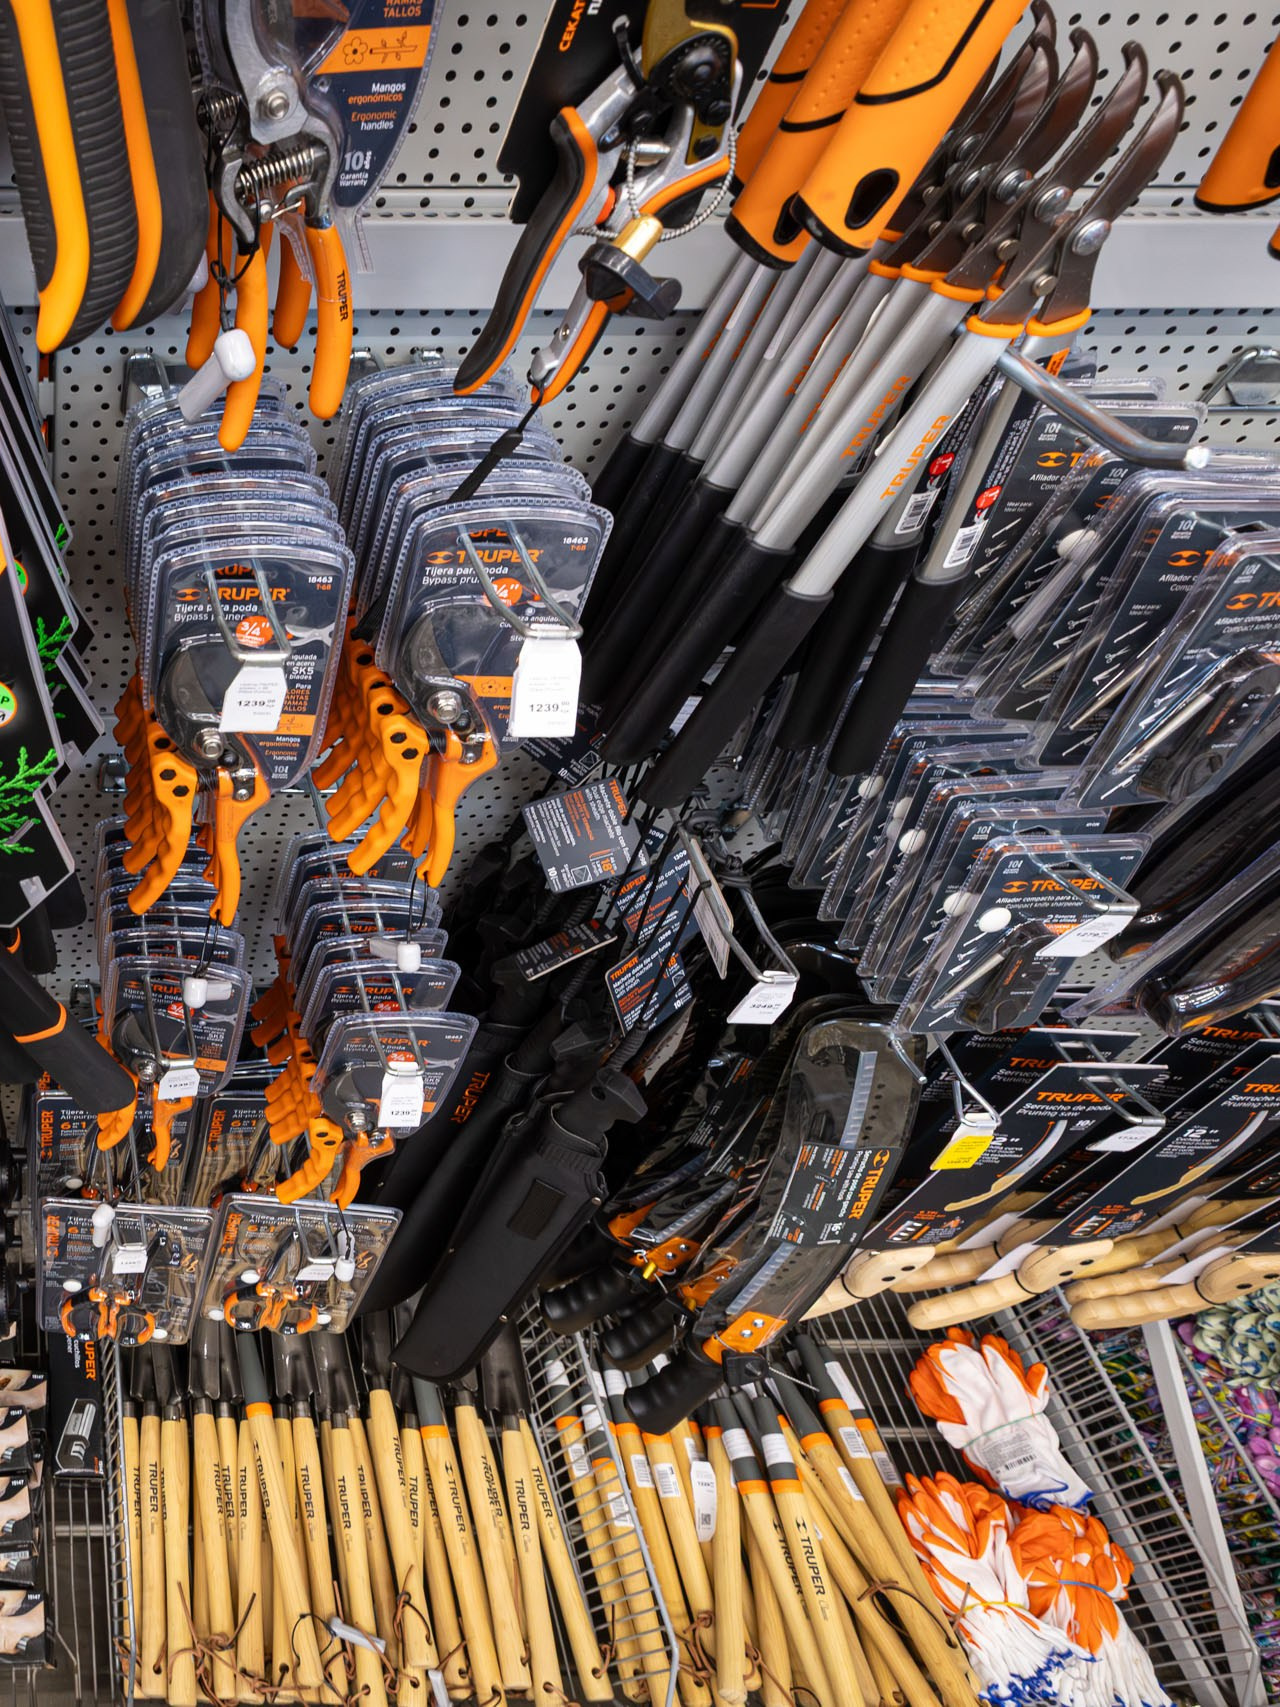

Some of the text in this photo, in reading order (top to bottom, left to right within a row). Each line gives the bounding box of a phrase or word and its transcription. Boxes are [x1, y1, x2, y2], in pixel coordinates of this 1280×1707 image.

[384, 6, 421, 17] TALLOS
[348, 92, 403, 105] ergonómicos
[372, 82, 406, 94] Mangos
[351, 110, 397, 123] Ergonomic
[360, 119, 394, 131] handles
[344, 152, 364, 171] 10
[339, 178, 368, 187] Warranty
[336, 269, 350, 322] TRUPER
[839, 375, 912, 460] TRUPER
[880, 414, 952, 500] TRUPER
[1029, 474, 1058, 482] Afilador
[563, 536, 589, 544] 18463
[308, 575, 333, 584] 18463
[422, 576, 457, 585] Bypass
[424, 566, 454, 577] Tijera
[1158, 574, 1190, 582] Afilador
[174, 613, 209, 623] Bypass
[175, 603, 258, 613] Tijera pra poda
[1214, 617, 1243, 626] Afilador
[291, 667, 314, 675] SK5
[528, 703, 559, 712] 1239
[598, 783, 618, 826] Machete doble
[608, 779, 628, 818] TRUPER
[610, 956, 639, 981] TRUPER
[613, 941, 671, 988] Machete funda
[450, 1071, 491, 1124] TRUPER
[1016, 1109, 1058, 1118] Pruning
[1023, 1103, 1071, 1111] Serrucho
[41, 1110, 54, 1148] TRUPER
[210, 1109, 226, 1147] TRUPER
[848, 1168, 884, 1220] TRUPER
[46, 1215, 60, 1248] TRUPER
[224, 1213, 243, 1248] TRUPER
[392, 1436, 406, 1487] TRUPER
[133, 1467, 142, 1518] TRUPER
[148, 1461, 158, 1513] TRUPER
[213, 1462, 223, 1514] TRUPER
[222, 1465, 235, 1519] TRUPER
[239, 1466, 248, 1518] TRUPER
[256, 1456, 271, 1508] TRUPER
[300, 1465, 315, 1519] TRUPER
[532, 1466, 553, 1518] TRUPER
[337, 1475, 352, 1530] TRUPER
[409, 1476, 419, 1528] TRUPER
[448, 1479, 466, 1532] TRUPER
[515, 1478, 530, 1531] TRUPER
[778, 1537, 803, 1596] TRUPER
[800, 1537, 826, 1596] TRUPER
